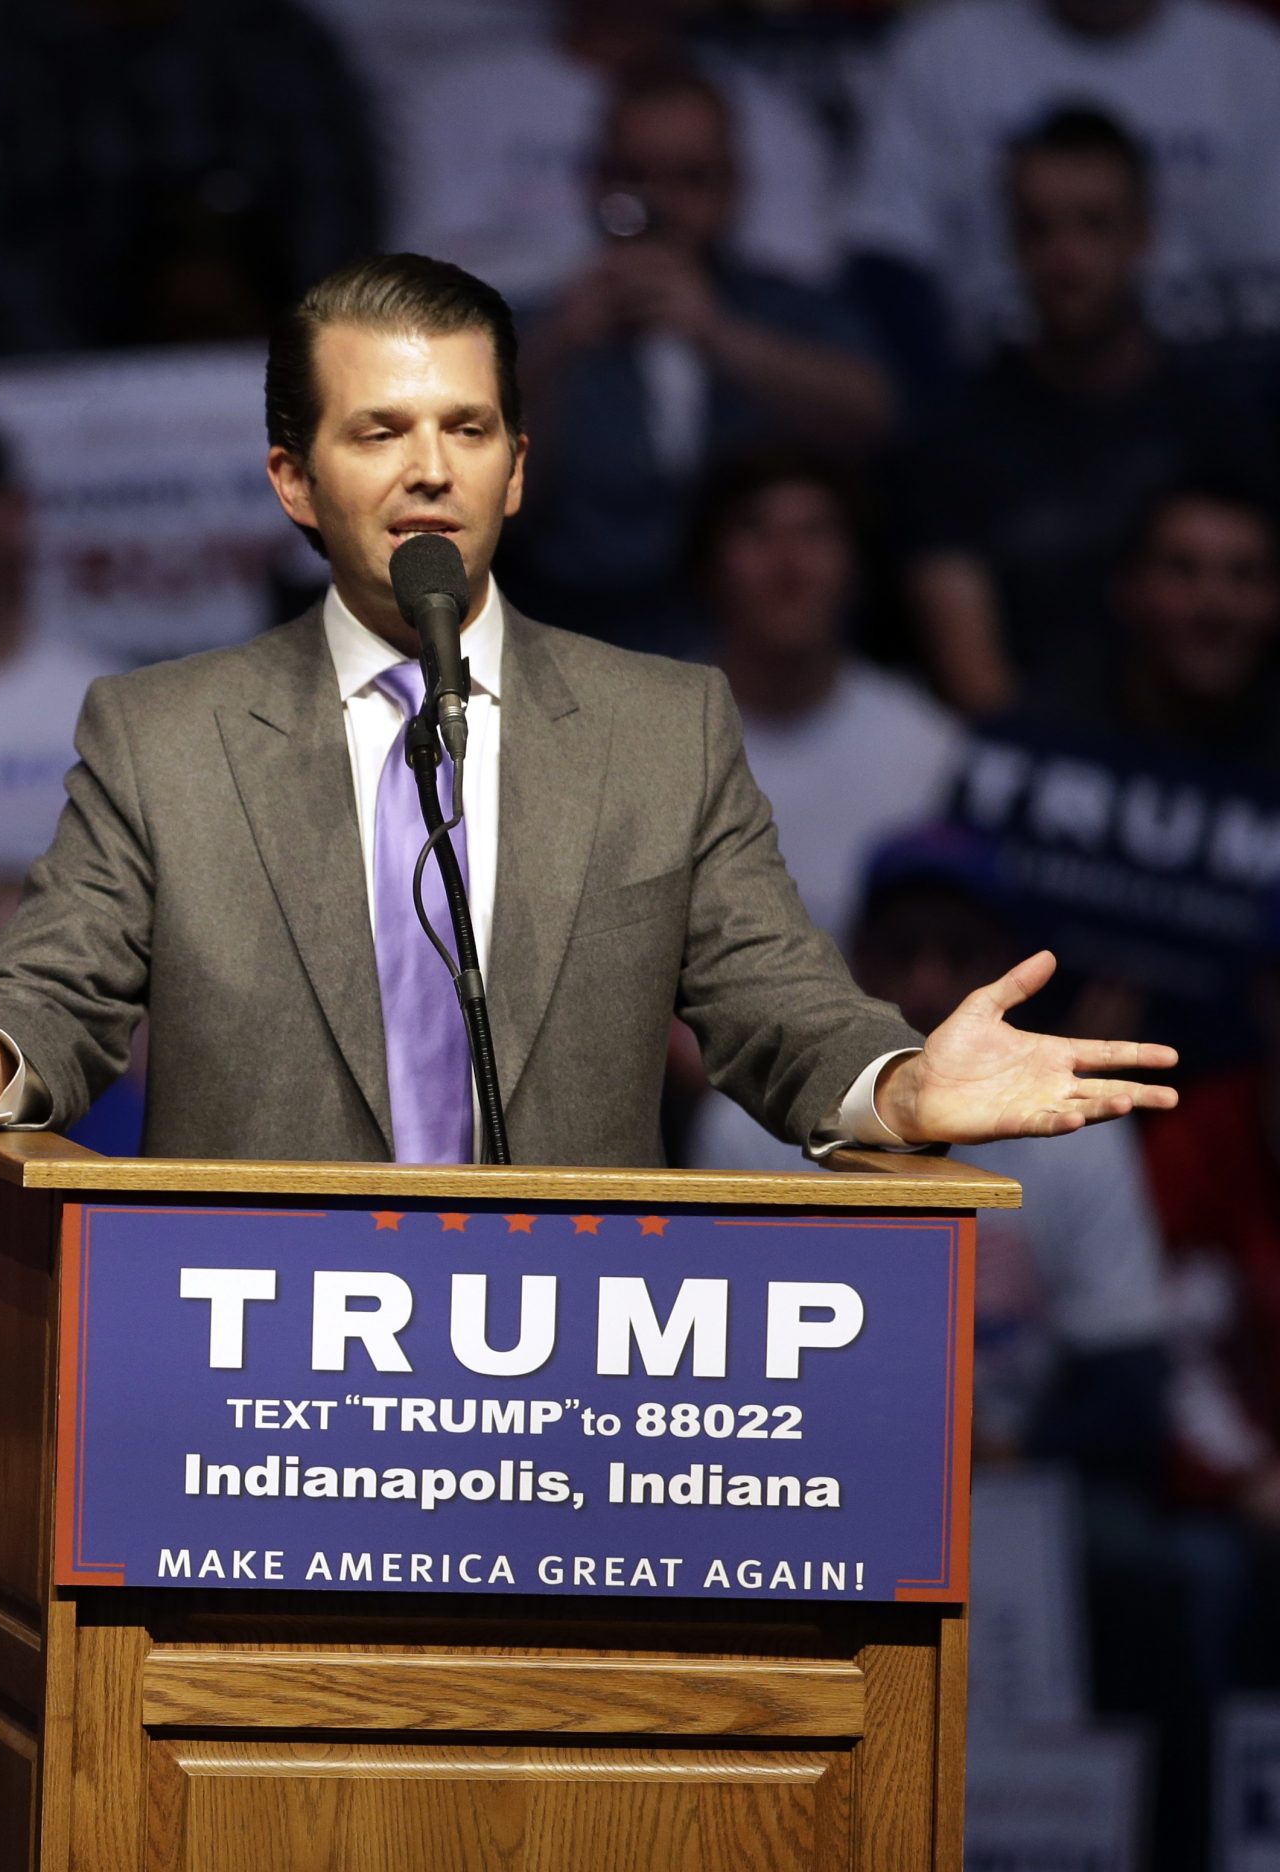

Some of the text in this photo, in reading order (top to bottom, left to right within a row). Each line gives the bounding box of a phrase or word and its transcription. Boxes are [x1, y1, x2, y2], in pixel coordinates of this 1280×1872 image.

[960, 738, 1280, 884] TRUM
[179, 1267, 865, 1379] TRUMP
[226, 1394, 804, 1441] TEXT “TRUMP” to 88022
[184, 1454, 842, 1511] Indianapolis, Indiana
[157, 1548, 865, 1592] MAKE AMERICA GREAT AGAIN!
